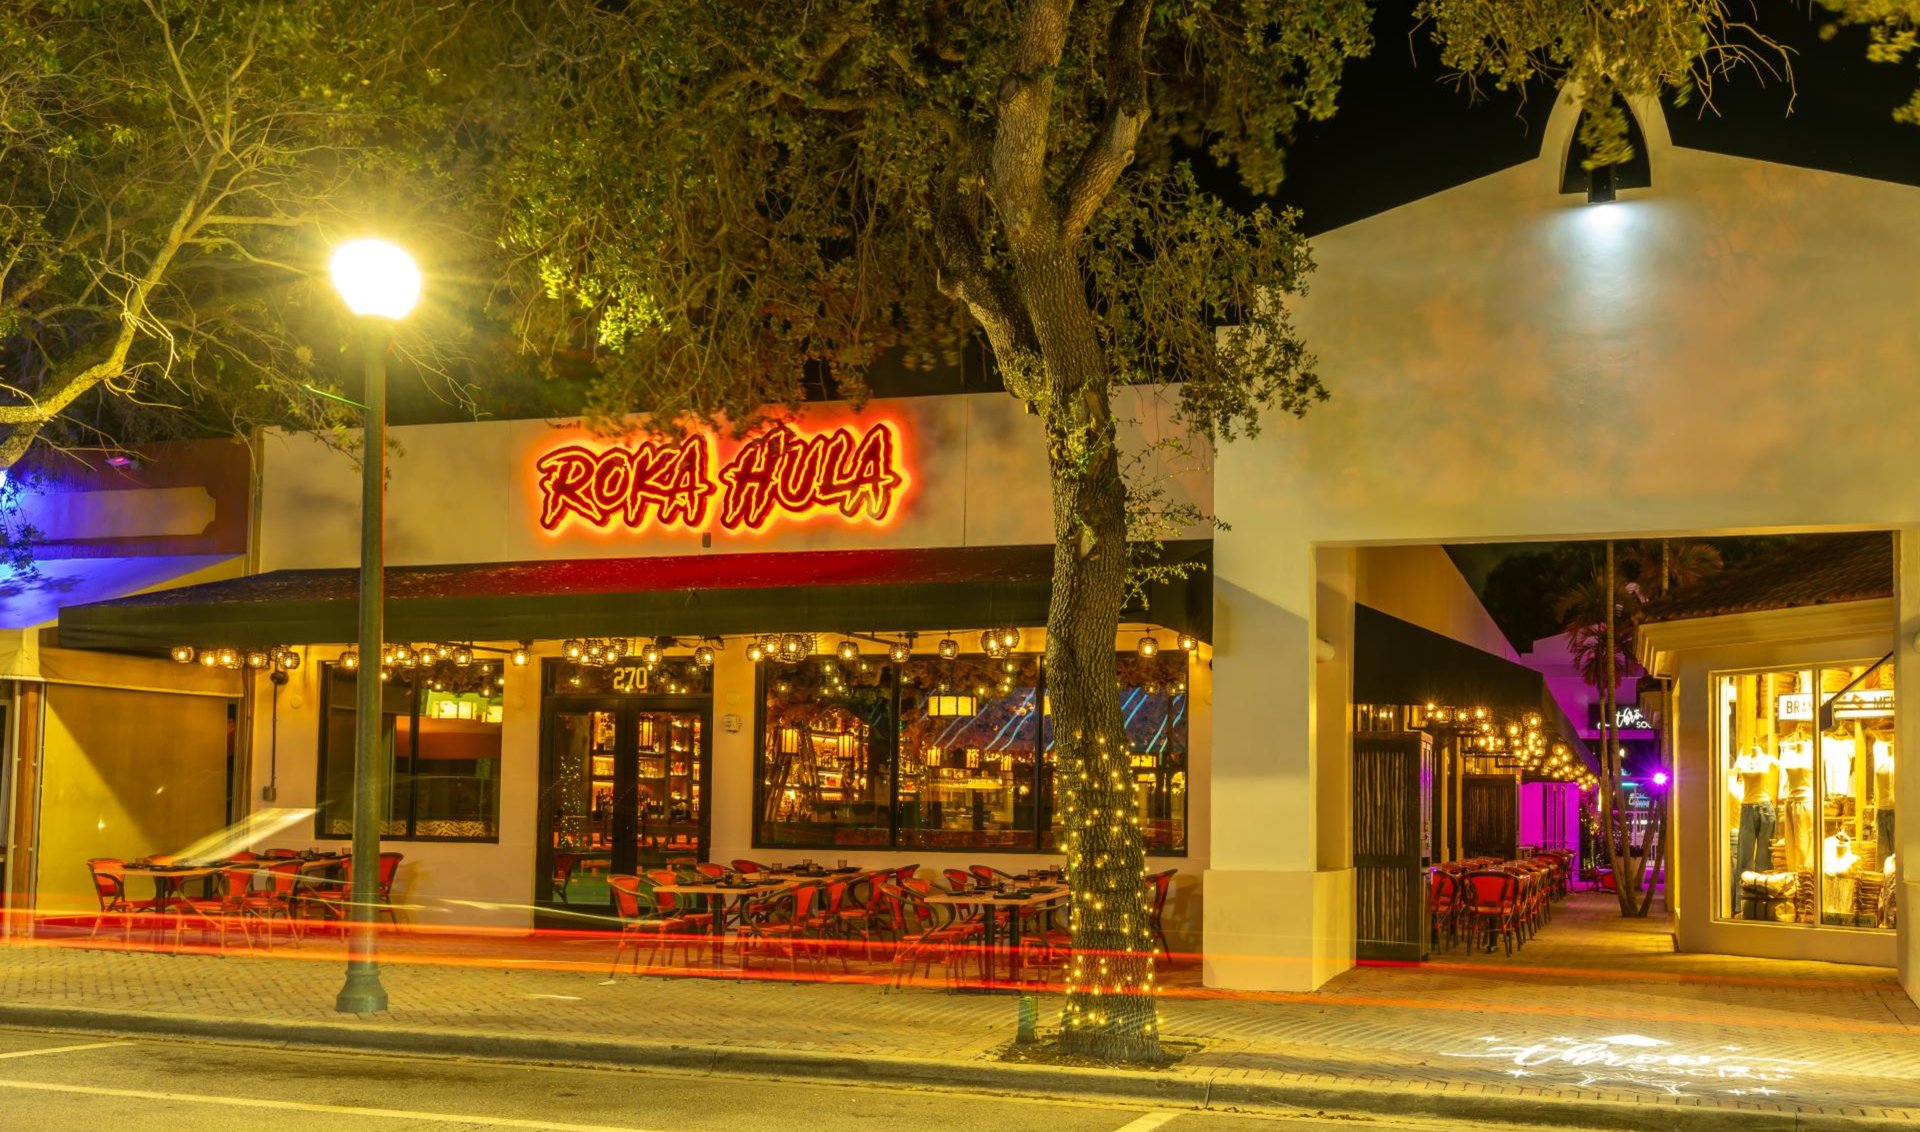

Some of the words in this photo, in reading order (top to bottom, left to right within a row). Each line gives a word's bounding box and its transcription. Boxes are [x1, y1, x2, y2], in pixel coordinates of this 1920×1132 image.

[537, 434, 716, 529] ROKA
[718, 424, 901, 528] HULA
[613, 667, 648, 690] 270
